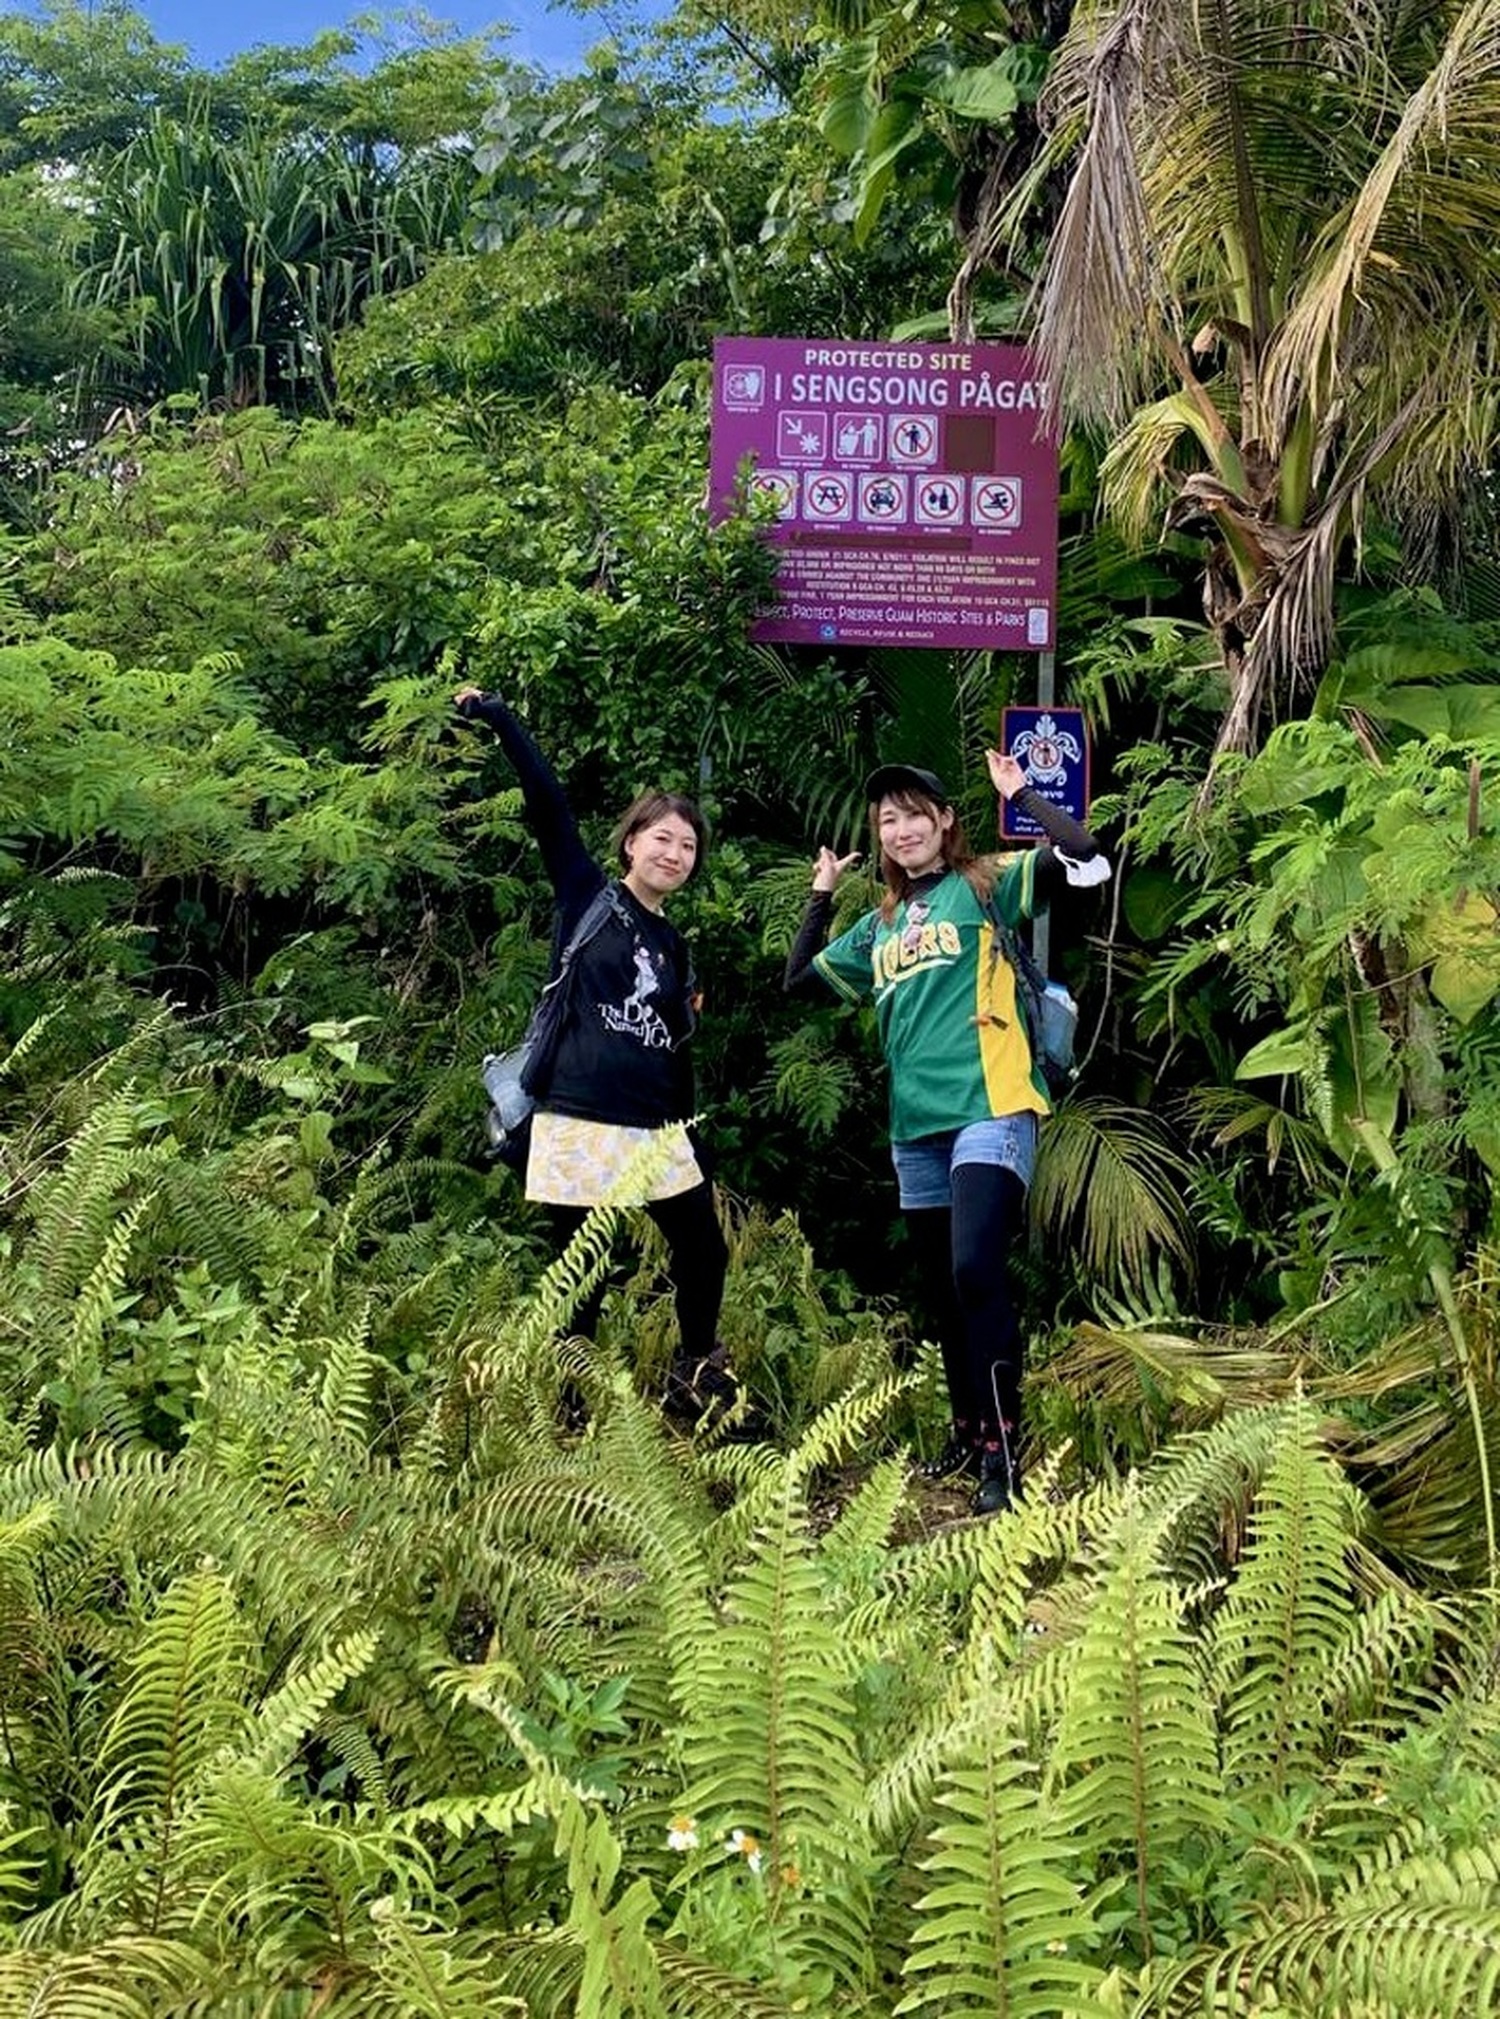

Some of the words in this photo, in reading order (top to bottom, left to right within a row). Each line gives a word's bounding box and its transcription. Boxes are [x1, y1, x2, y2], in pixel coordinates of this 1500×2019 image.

[805, 349, 923, 370] PROTECTED
[929, 352, 972, 371] SITE
[774, 373, 782, 401] I
[791, 374, 948, 406] SENGSONG
[838, 605, 884, 622] PRESERVE
[885, 606, 914, 622] GUAM
[916, 608, 958, 624] HISTORIC
[960, 610, 984, 626] SITES
[995, 610, 1026, 627] PARKS
